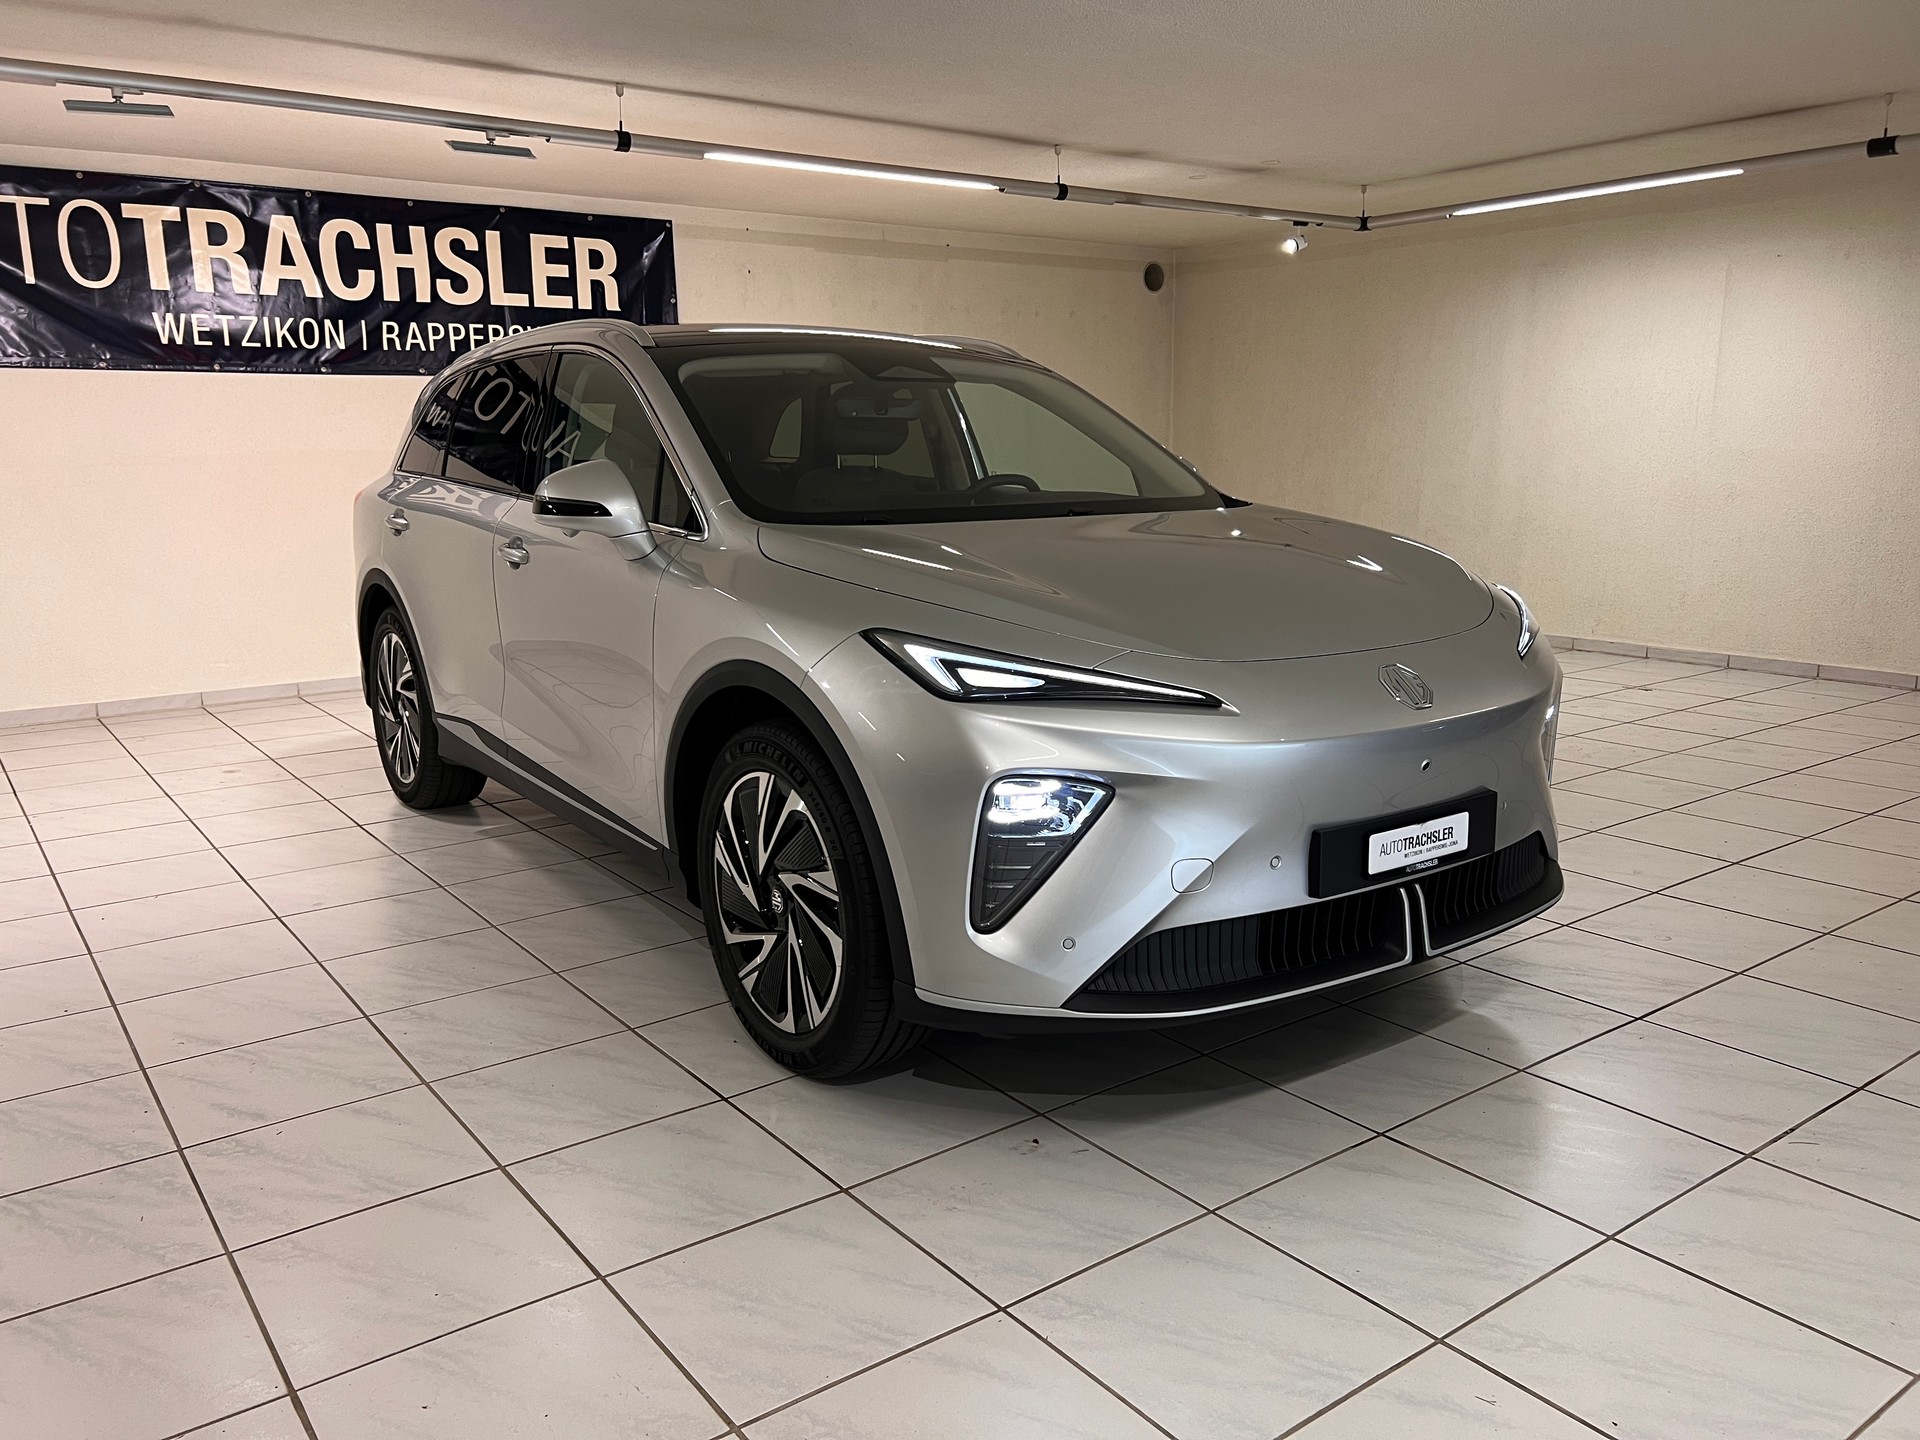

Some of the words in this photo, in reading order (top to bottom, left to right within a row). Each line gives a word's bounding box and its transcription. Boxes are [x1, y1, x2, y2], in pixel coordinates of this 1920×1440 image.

[152, 312, 346, 350] WETZIKON
[743, 741, 804, 783] MICHELIN
[1380, 826, 1454, 857] AUTOTRACHSLER
